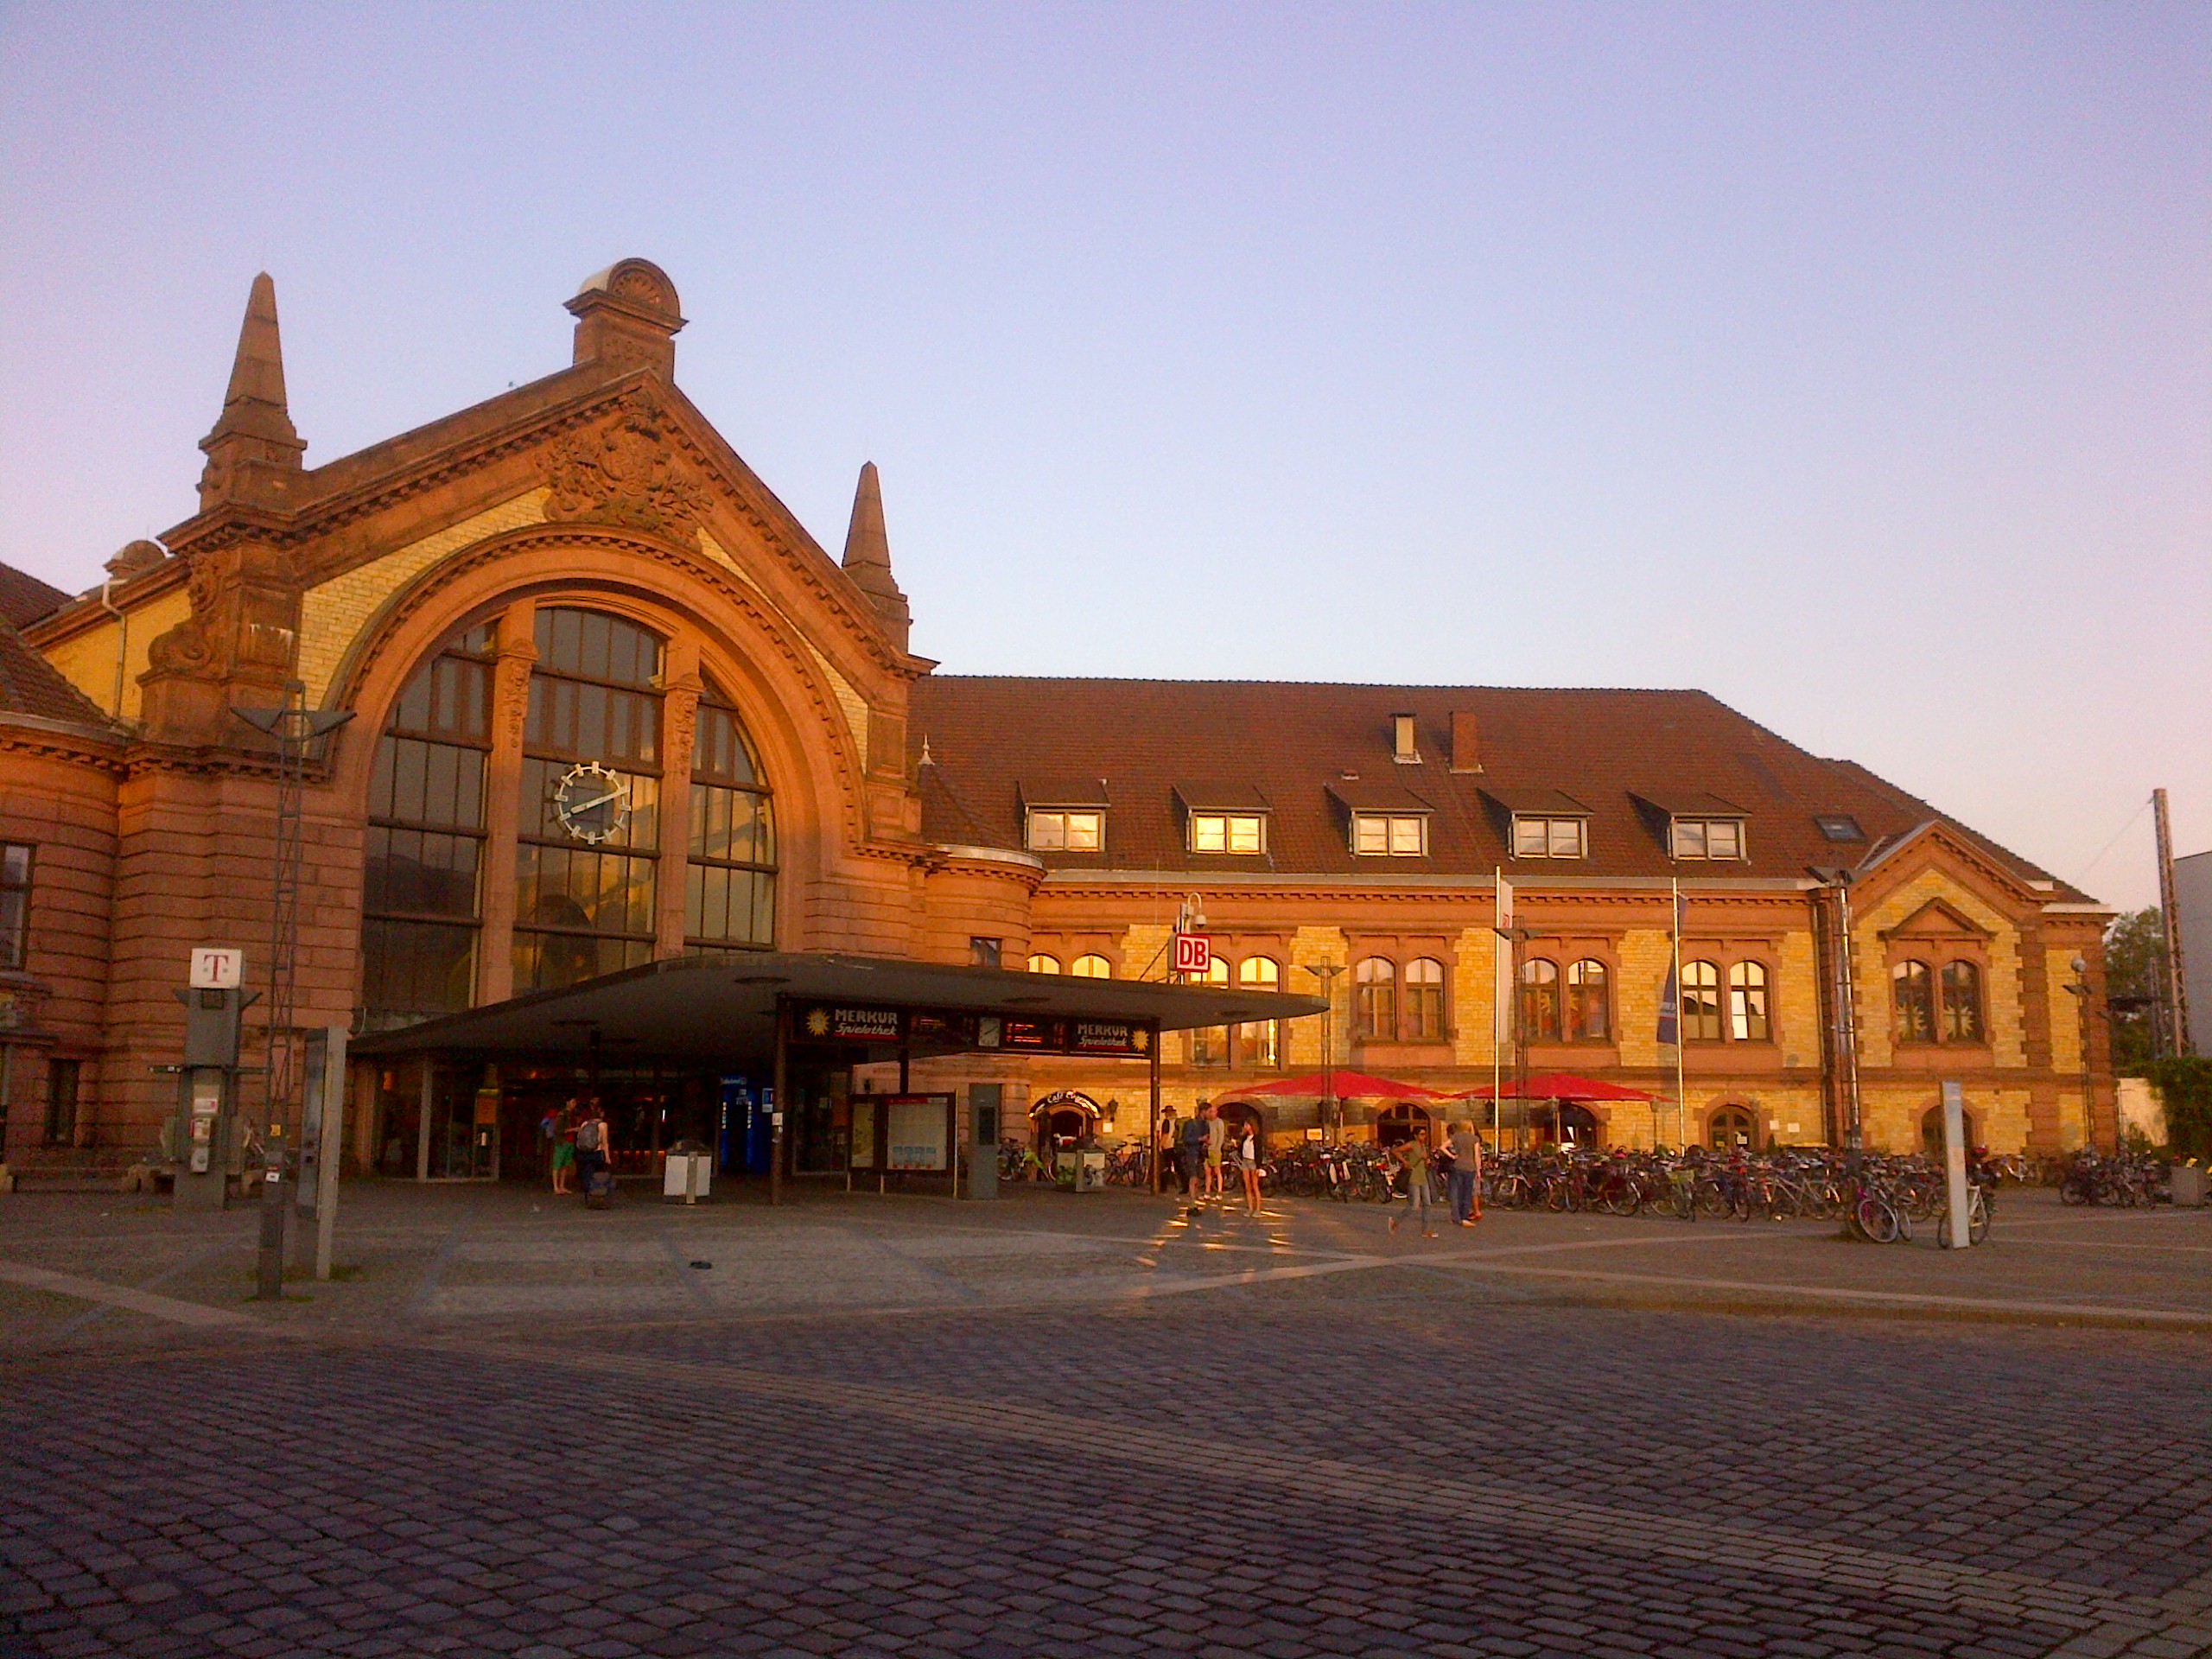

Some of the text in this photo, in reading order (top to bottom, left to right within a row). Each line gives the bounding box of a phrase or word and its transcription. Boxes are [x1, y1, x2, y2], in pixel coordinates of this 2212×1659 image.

[1179, 939, 1206, 967] DB
[203, 954, 229, 982] T
[834, 1008, 898, 1025] MERKUR
[1077, 1023, 1128, 1037] MERKUR
